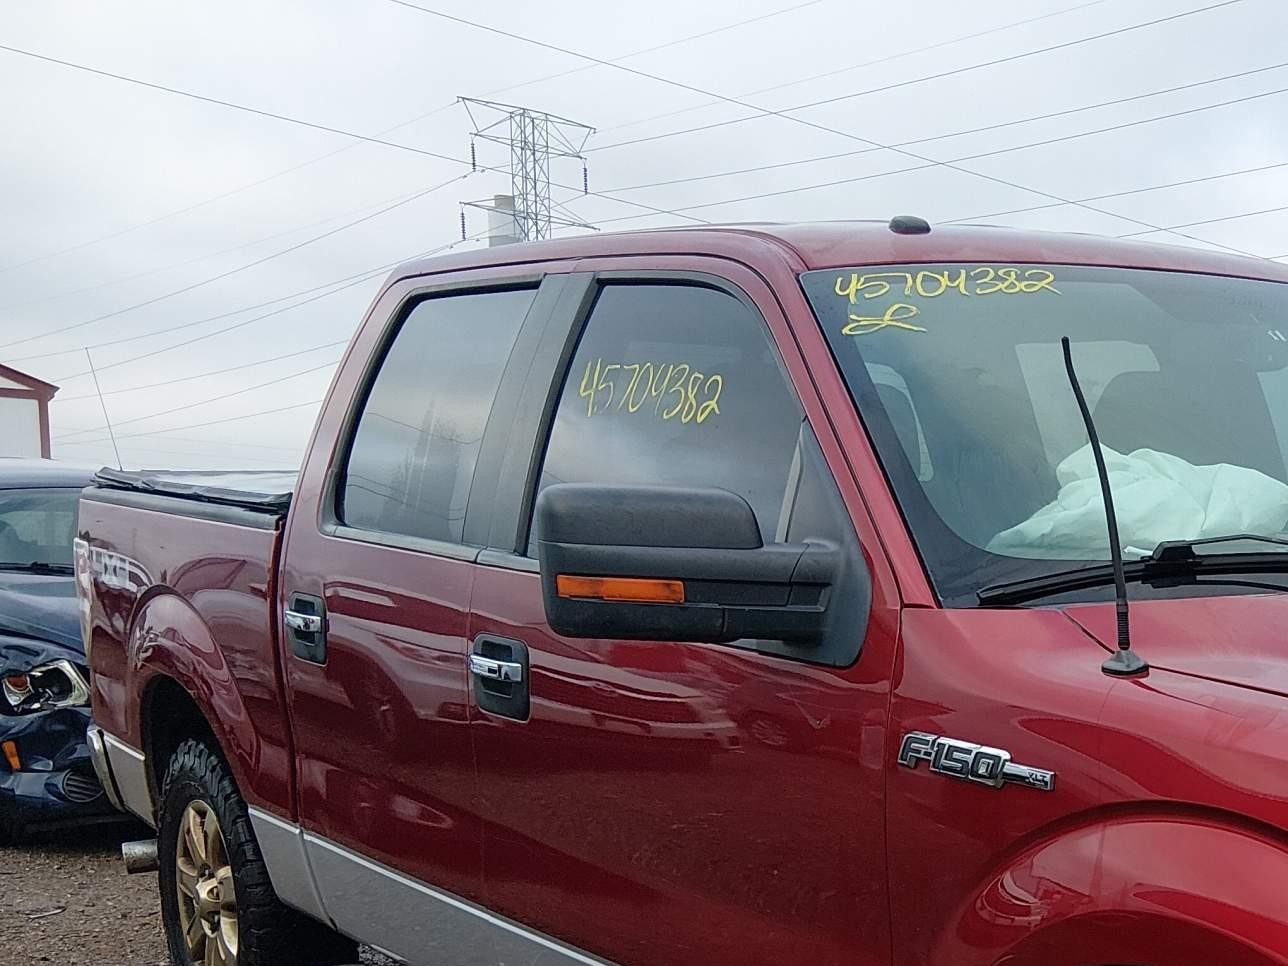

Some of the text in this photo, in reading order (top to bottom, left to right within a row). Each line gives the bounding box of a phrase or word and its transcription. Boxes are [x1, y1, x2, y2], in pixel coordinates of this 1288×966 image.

[834, 267, 1062, 304] 45704382
[579, 357, 724, 424] 45704382
[897, 731, 1011, 788] F-150
